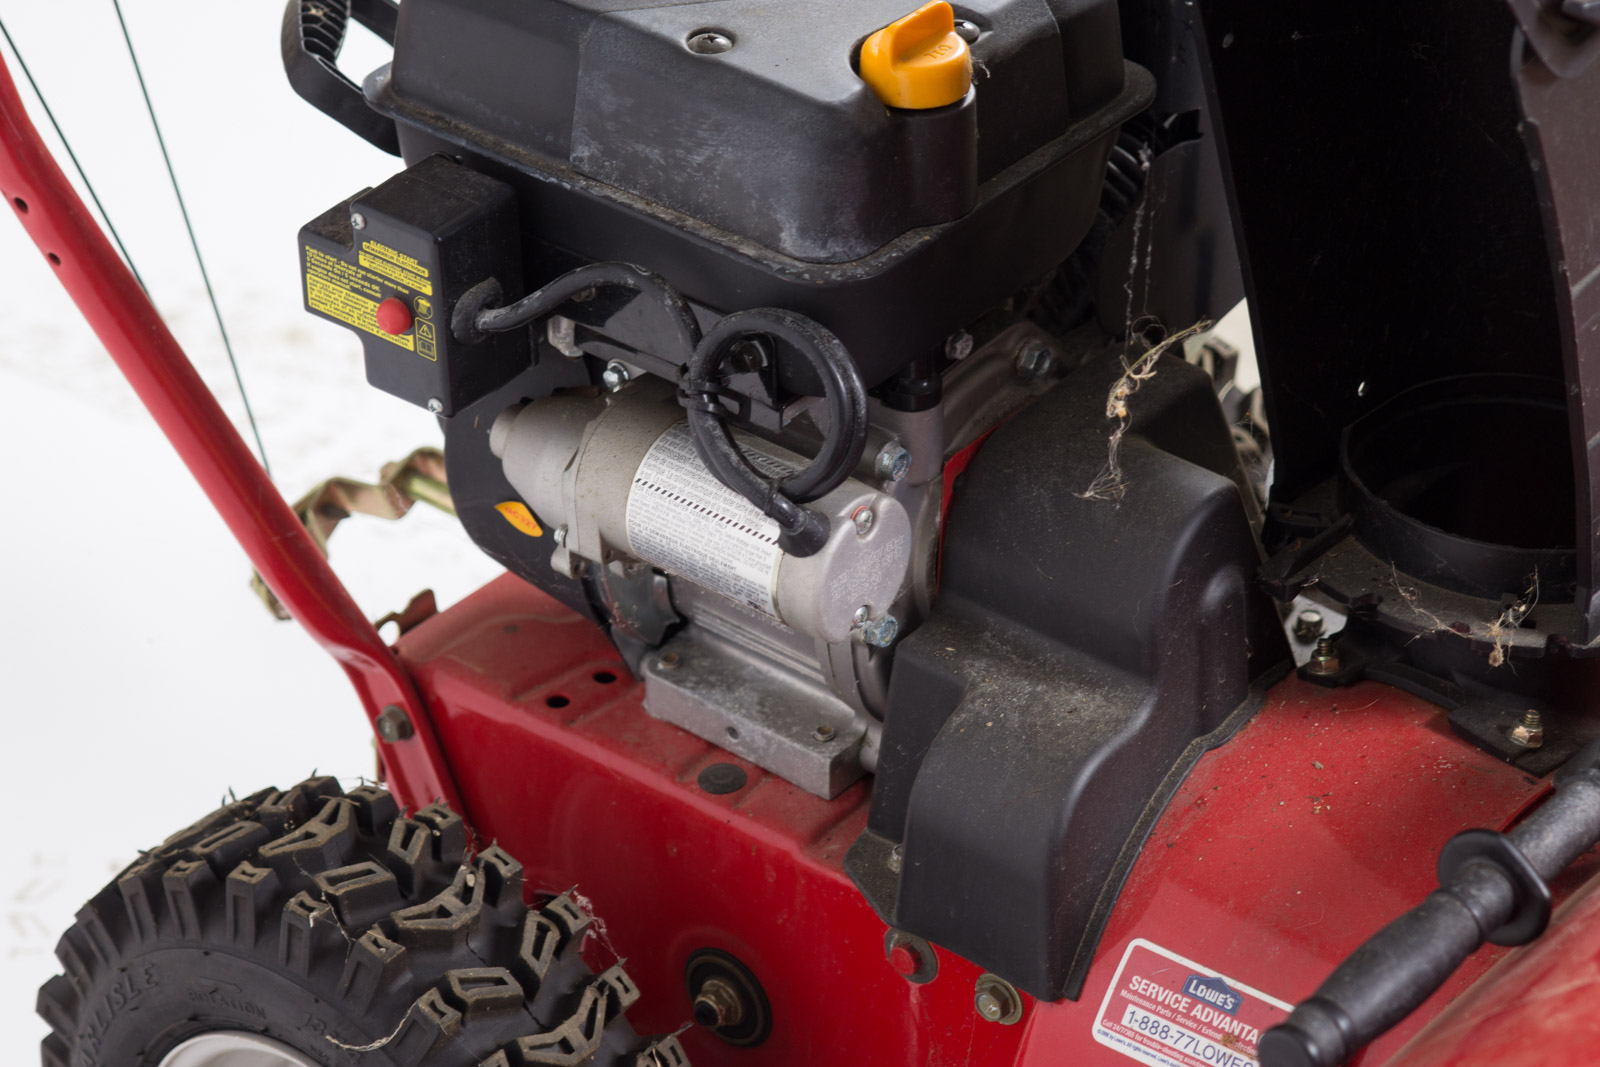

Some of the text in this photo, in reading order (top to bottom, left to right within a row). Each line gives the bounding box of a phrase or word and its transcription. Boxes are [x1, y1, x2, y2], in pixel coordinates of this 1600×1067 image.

[924, 44, 953, 59] OIL
[313, 254, 327, 264] times
[370, 239, 418, 266] ELECTRIC START
[367, 272, 383, 284] starter
[384, 279, 396, 290] more
[189, 990, 267, 1019] ROTATION
[1120, 989, 1157, 1011] Maintenance
[1156, 1006, 1174, 1019] Parts
[1175, 1015, 1198, 1030] Service
[1129, 975, 1265, 1045] SERVICE ADVANTA
[1102, 1018, 1114, 1029] Call
[1134, 1033, 1144, 1042] for
[1142, 1037, 1184, 1062] trouble-shooting
[1127, 1010, 1254, 1067] 1-888-77LOWE
